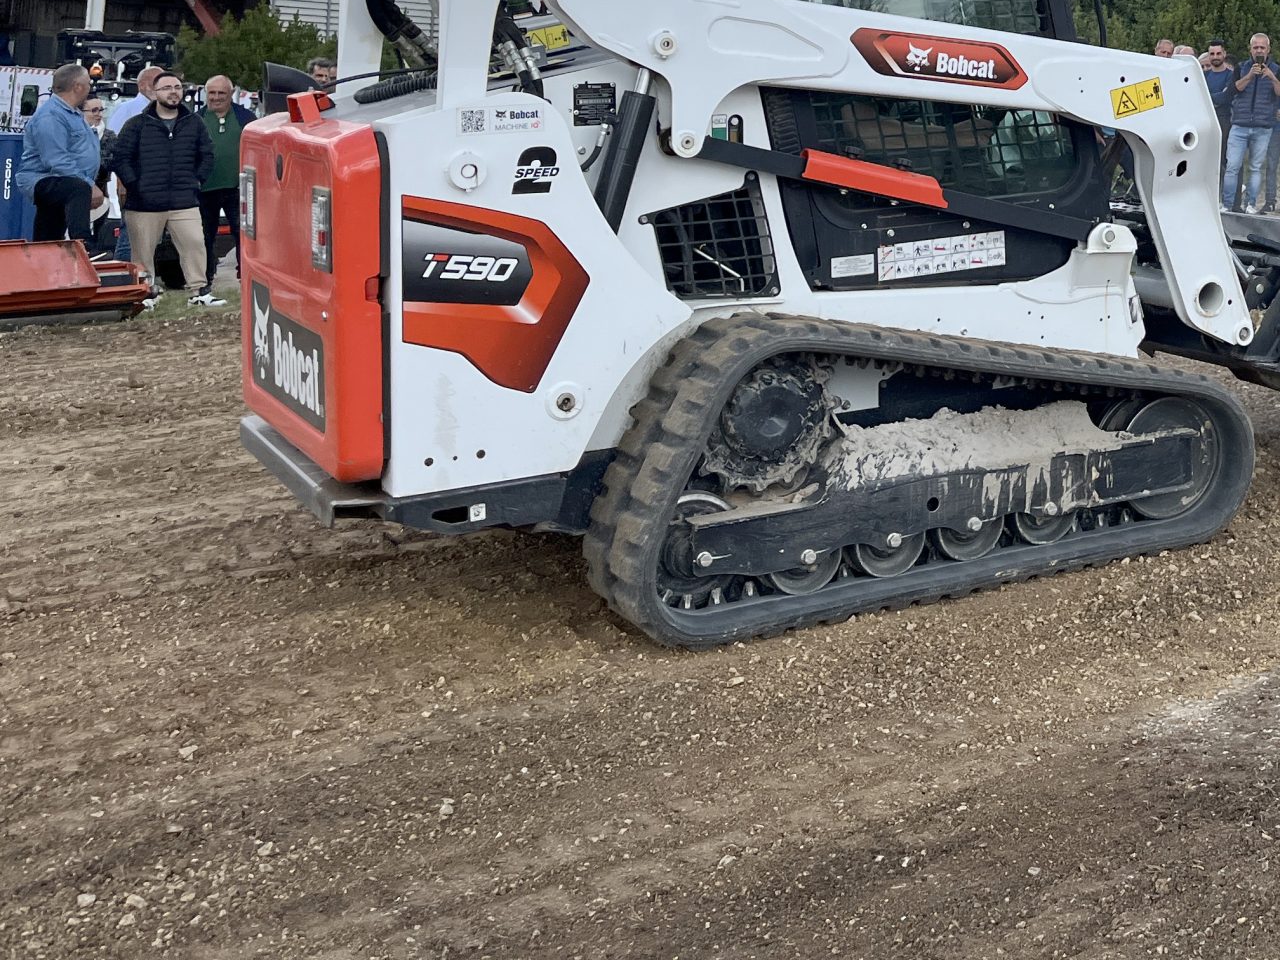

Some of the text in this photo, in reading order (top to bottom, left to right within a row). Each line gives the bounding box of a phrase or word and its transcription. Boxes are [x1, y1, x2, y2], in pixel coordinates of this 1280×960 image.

[935, 52, 995, 79] Bobcat
[509, 110, 539, 120] Bobcat
[494, 122, 529, 131] MACHINE
[514, 167, 560, 179] SPEED
[422, 253, 519, 282] T590
[272, 321, 321, 417] Bobcat
